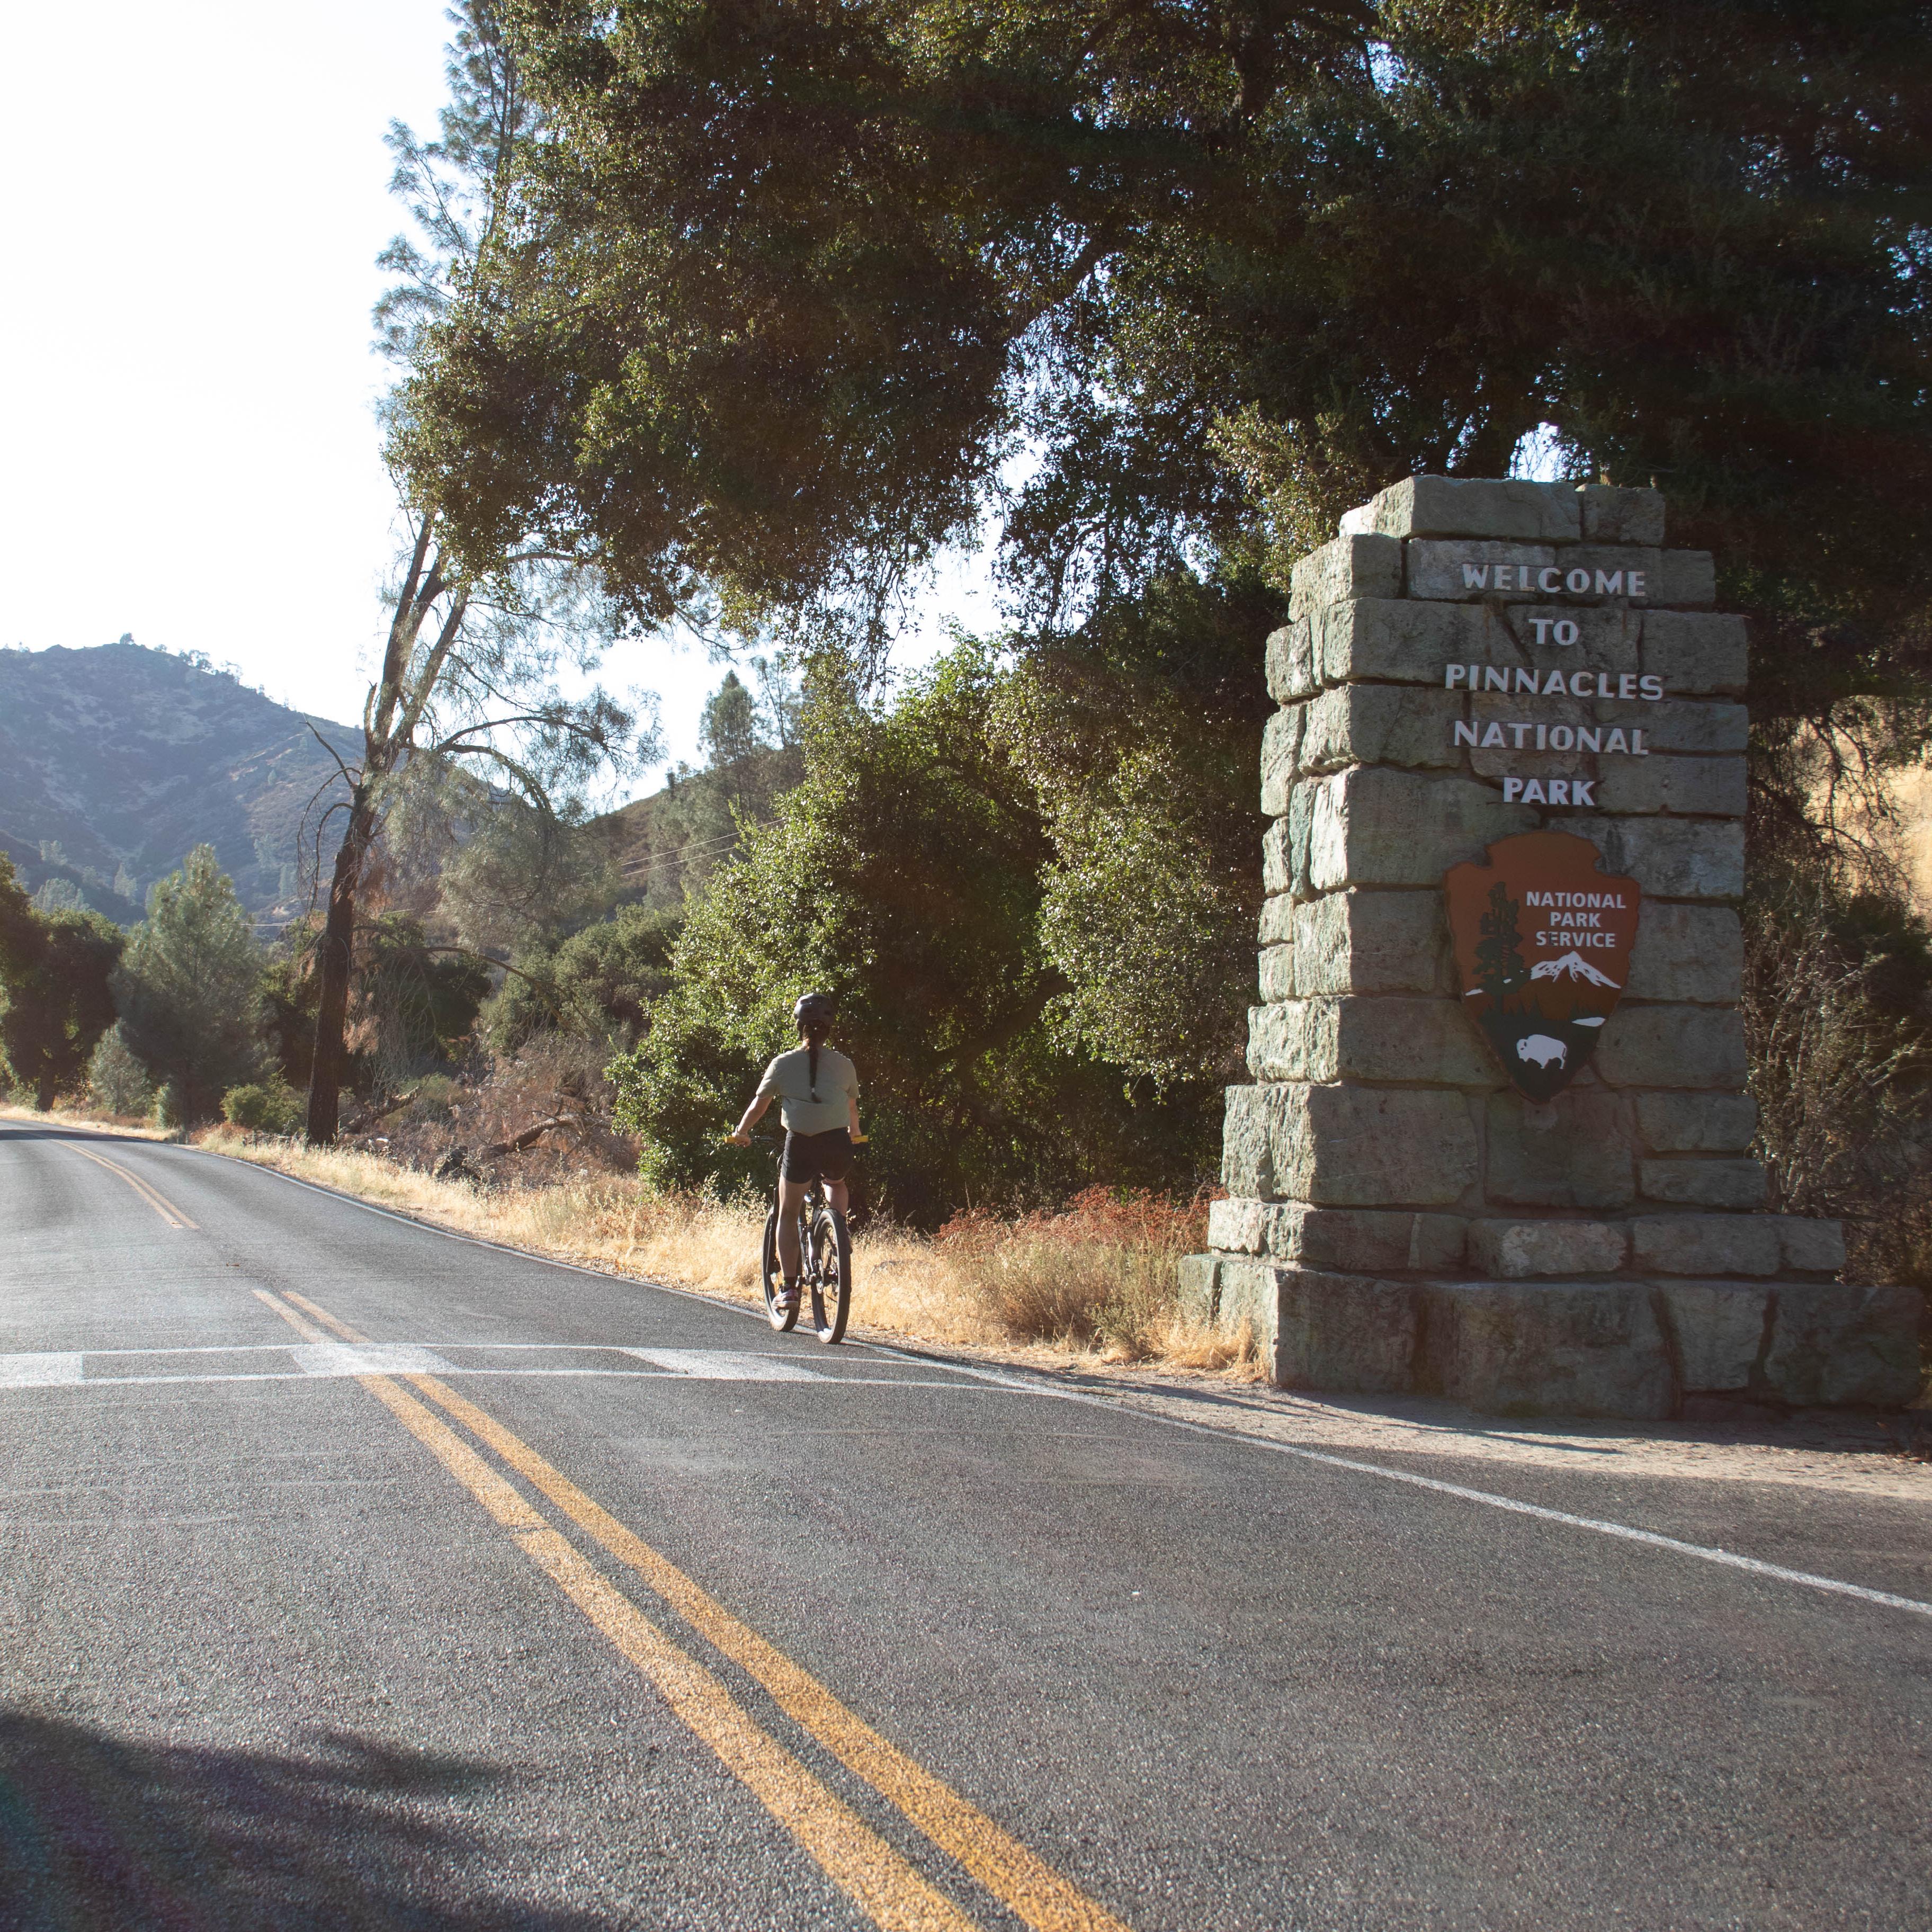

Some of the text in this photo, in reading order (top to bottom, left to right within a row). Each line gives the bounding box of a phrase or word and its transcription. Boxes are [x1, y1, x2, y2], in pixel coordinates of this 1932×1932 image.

[1461, 564, 1647, 597] WELCOME
[1528, 618, 1579, 646] TO
[1445, 664, 1663, 700] PINNACLES
[1454, 720, 1649, 755] NATIONAL
[1503, 777, 1595, 806] PARK
[1526, 891, 1626, 909] NATIONAL
[1550, 911, 1601, 928] PARK
[1536, 931, 1616, 948] SERVICE
